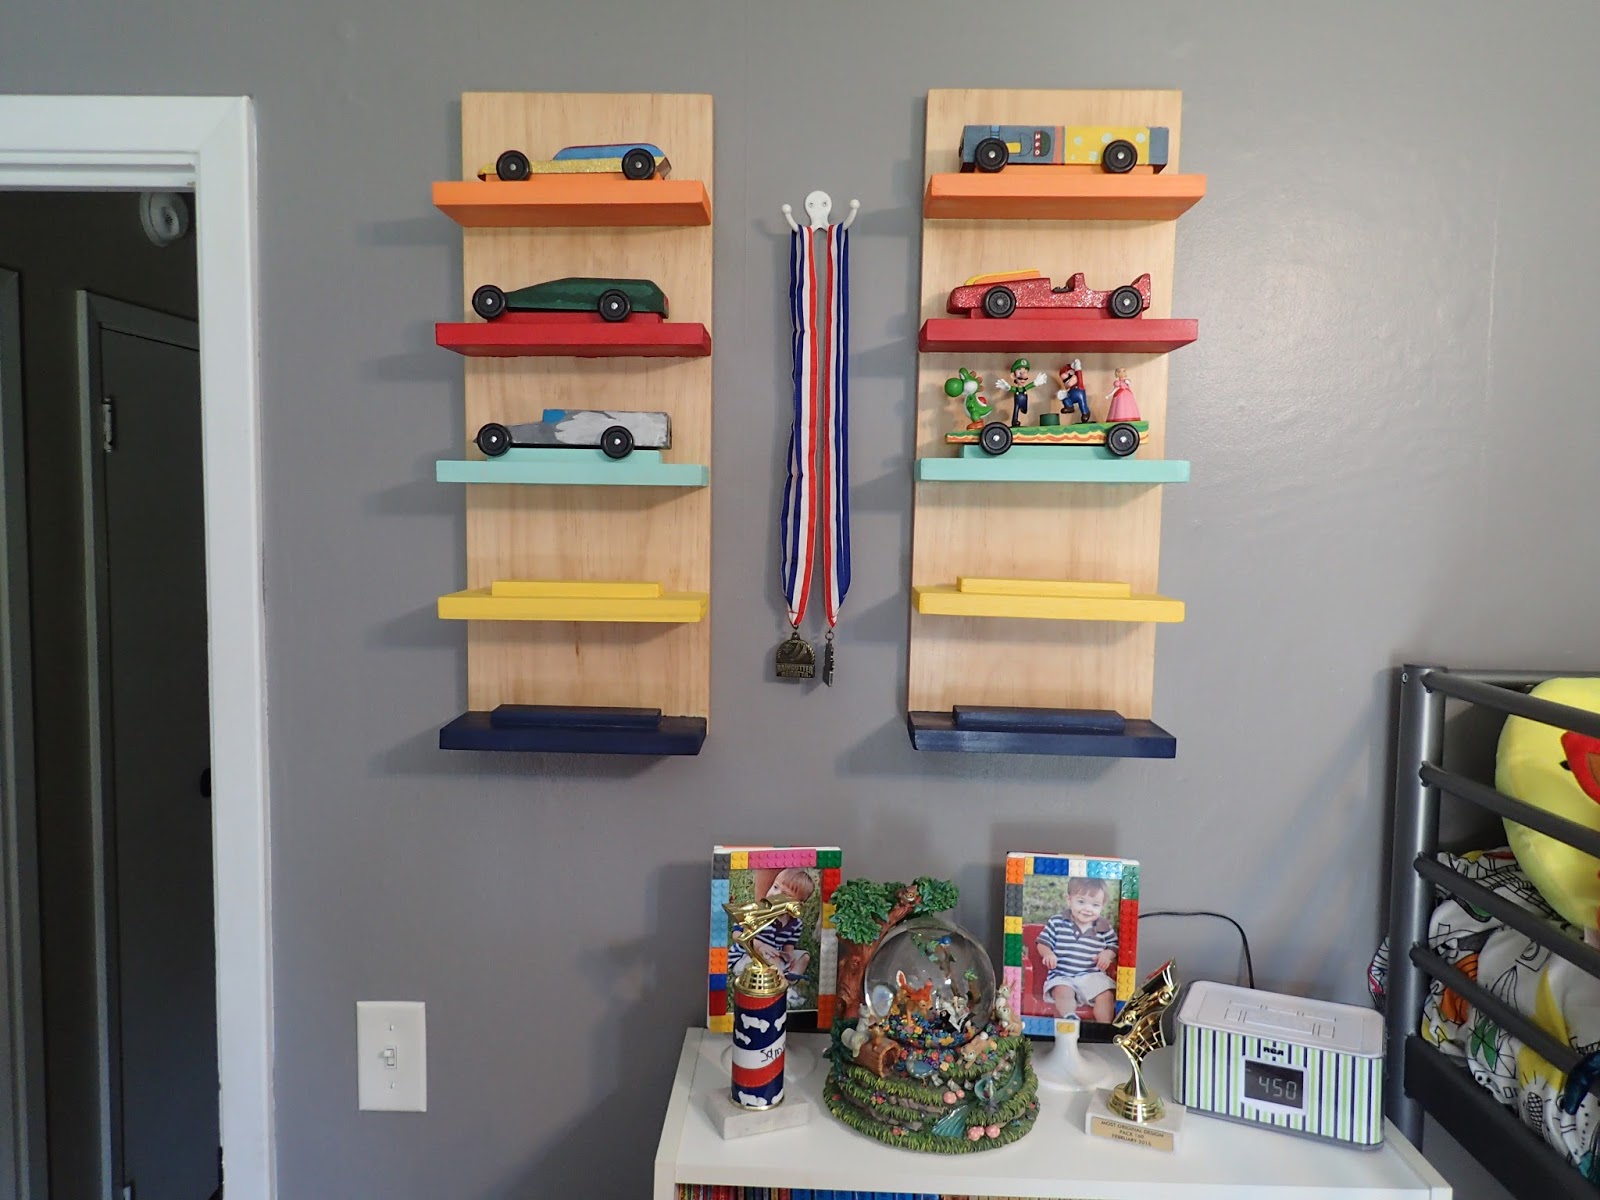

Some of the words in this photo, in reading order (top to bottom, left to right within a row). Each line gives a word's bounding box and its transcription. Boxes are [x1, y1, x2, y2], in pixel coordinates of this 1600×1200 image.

[1263, 1046, 1284, 1056] RCA
[1258, 1076, 1297, 1101] 450
[1117, 1124, 1142, 1134] ORIGINAL
[1143, 1129, 1164, 1138] DESIGN
[1119, 1129, 1133, 1137] PACK
[1111, 1133, 1137, 1143] FEBRUARY
